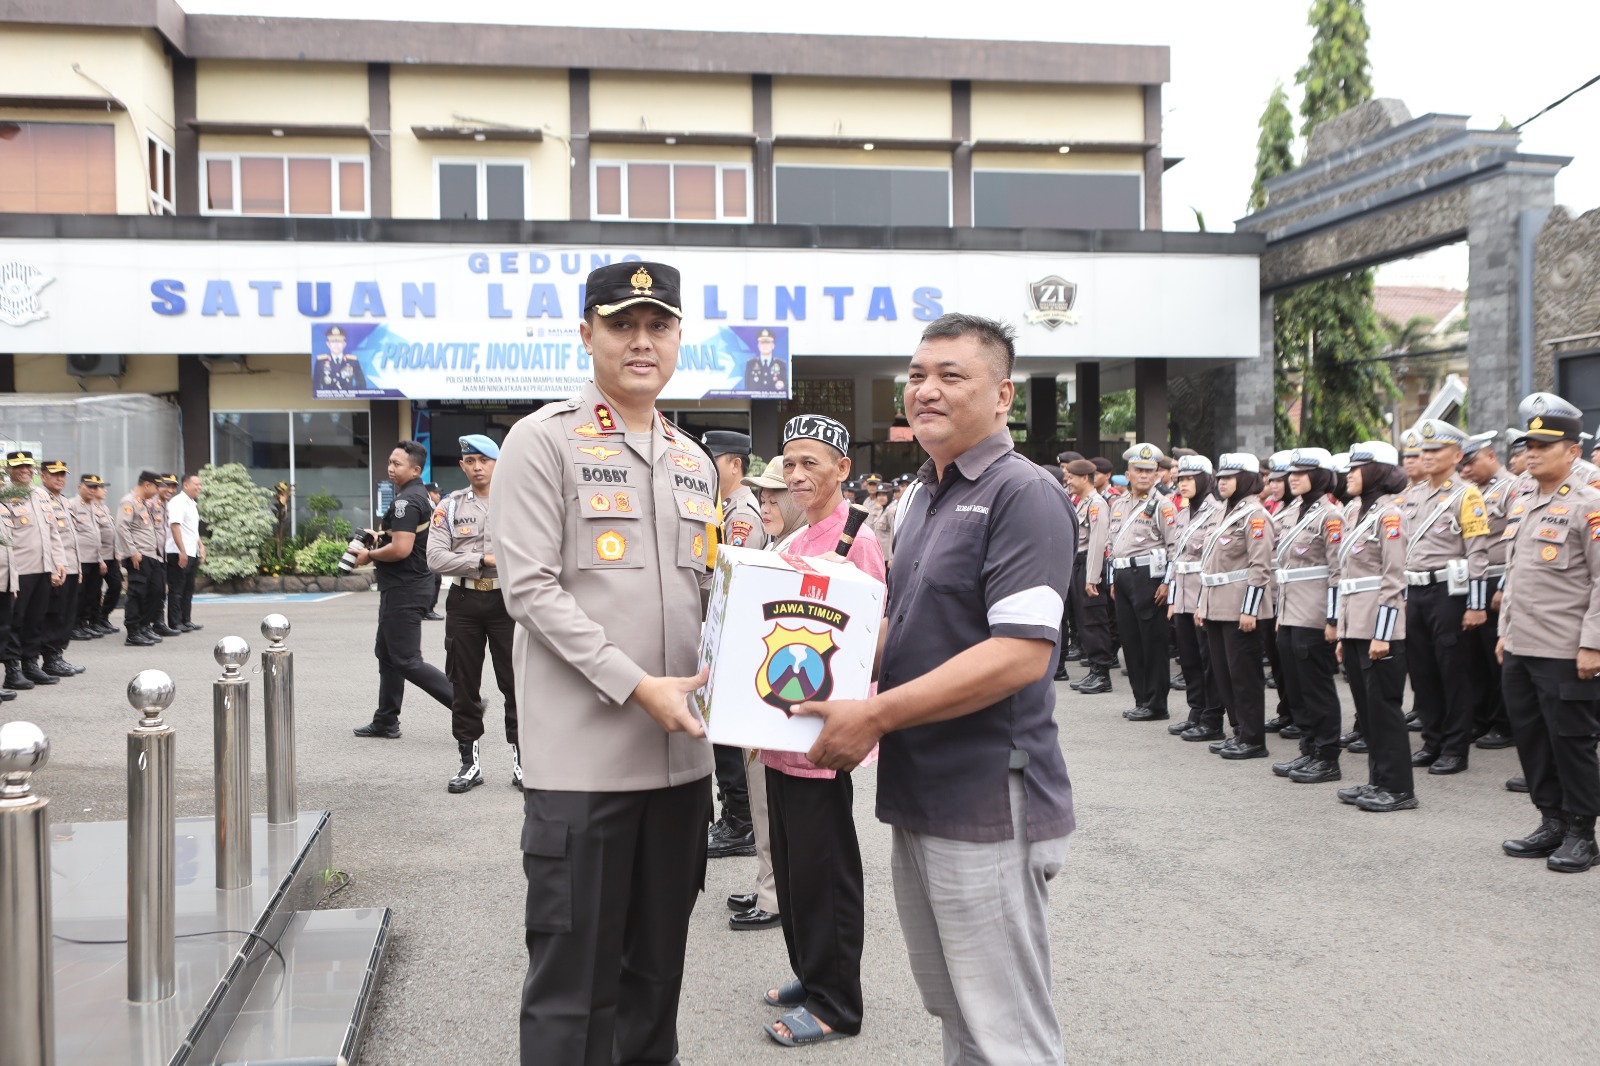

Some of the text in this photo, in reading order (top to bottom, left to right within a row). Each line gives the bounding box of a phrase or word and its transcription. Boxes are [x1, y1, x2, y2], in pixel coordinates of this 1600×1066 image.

[150, 279, 945, 322] SATUAN LA LINTAS
[380, 342, 480, 374] PROAKTIF,
[485, 342, 572, 370] INOVATIF
[446, 376, 463, 384] POLISI
[504, 376, 519, 384] PEKA
[520, 376, 532, 384] DAN
[533, 376, 554, 384] MAMPU
[582, 467, 628, 483] BOBBY
[674, 474, 710, 495] POLRI
[454, 517, 477, 526] BAYU
[1541, 515, 1569, 526] POLRI
[773, 603, 842, 624] JAWA TIMUR
